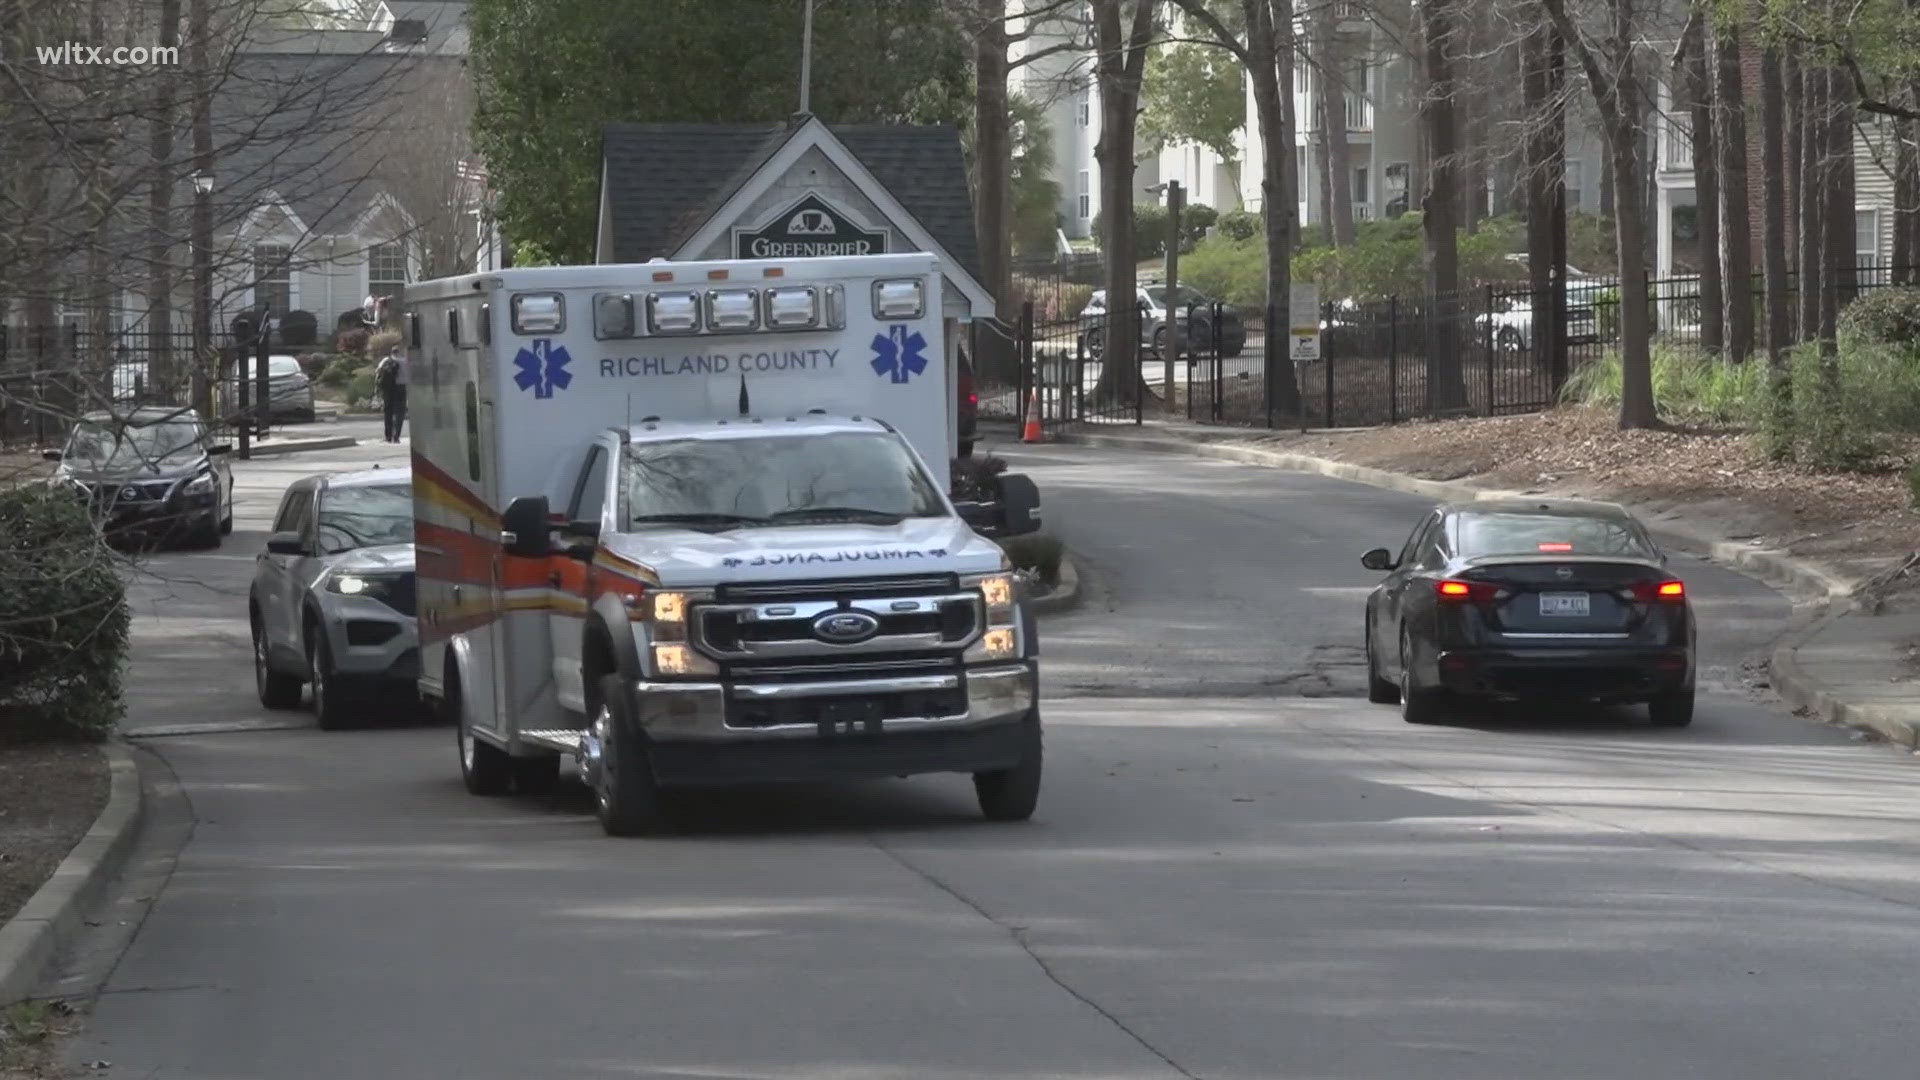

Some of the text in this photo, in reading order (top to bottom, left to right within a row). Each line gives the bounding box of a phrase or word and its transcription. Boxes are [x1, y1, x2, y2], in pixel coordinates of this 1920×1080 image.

[751, 237, 871, 257] GREENBRIER
[600, 349, 840, 377] RICHLAND COUNTY
